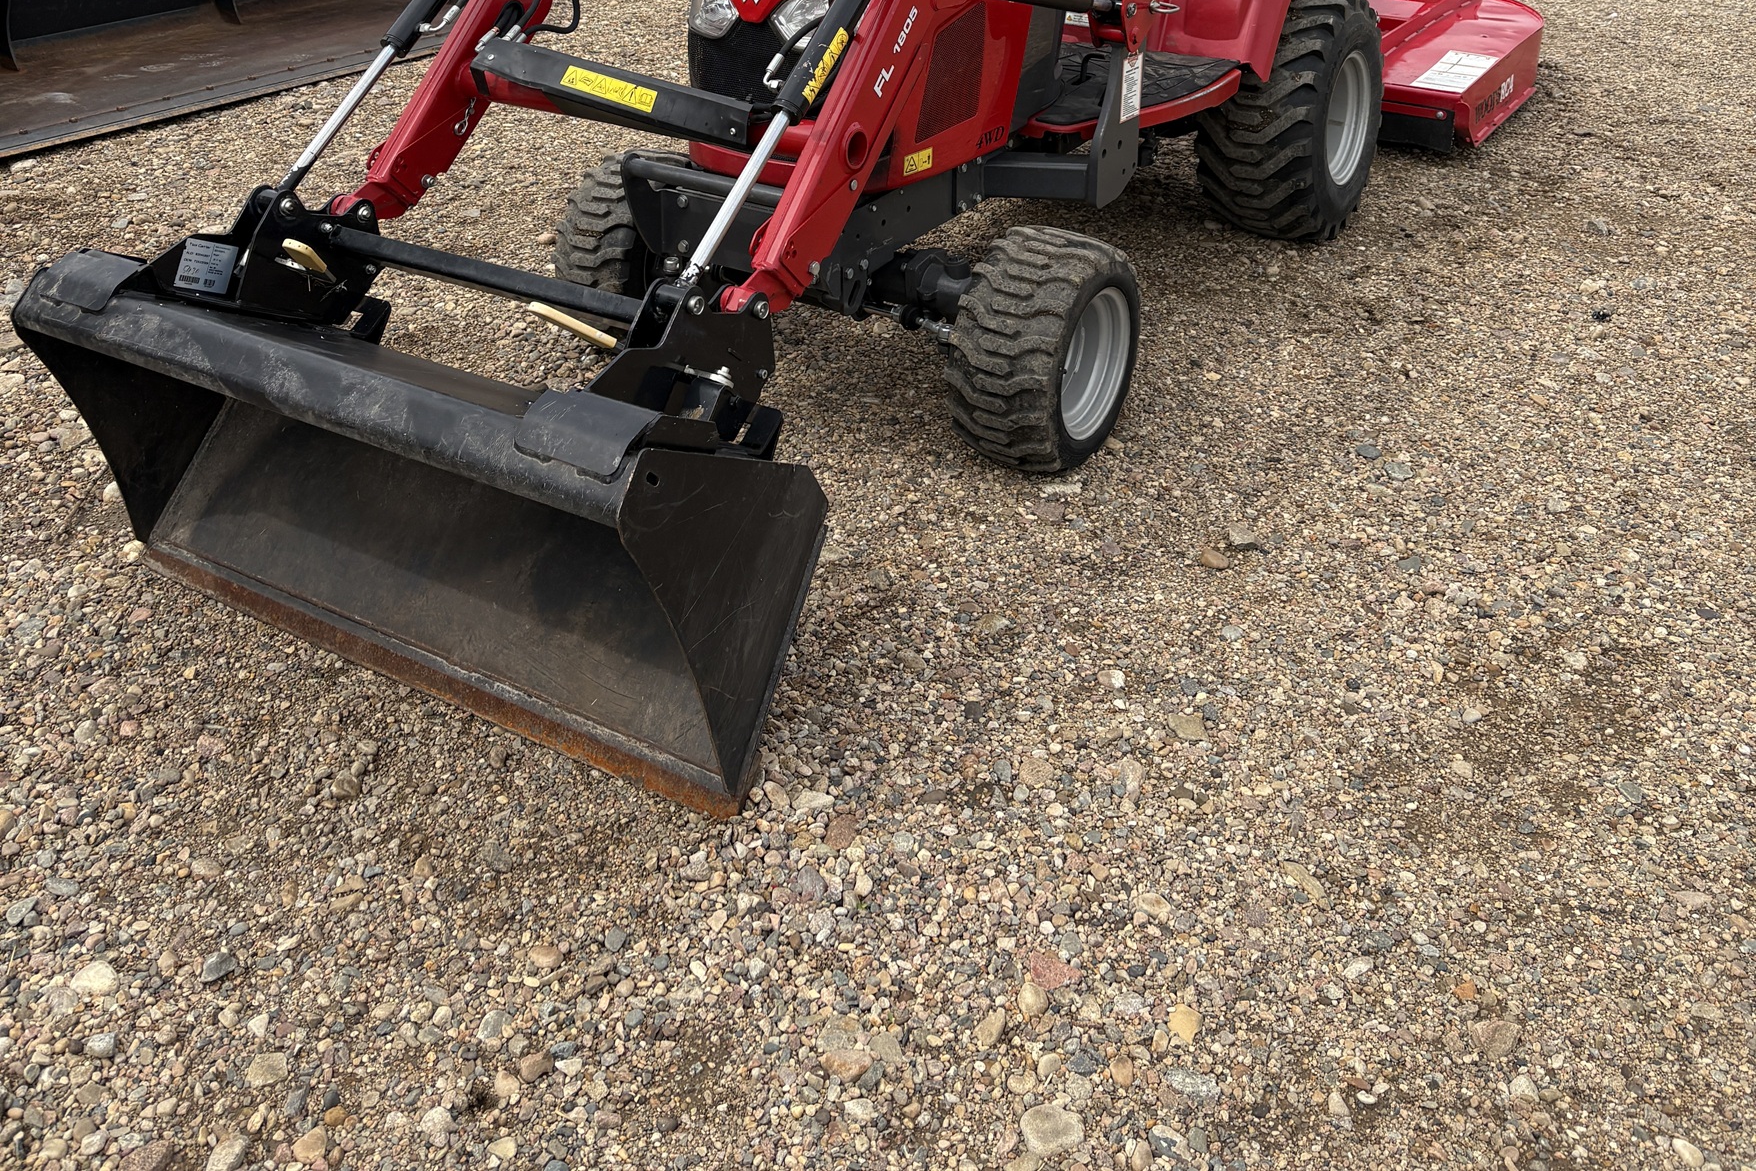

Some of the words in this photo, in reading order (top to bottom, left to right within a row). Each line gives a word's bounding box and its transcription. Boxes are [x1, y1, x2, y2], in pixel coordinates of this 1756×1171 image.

[873, 64, 895, 98] FL
[893, 5, 918, 54] 1805
[975, 125, 1005, 150] 4WD
